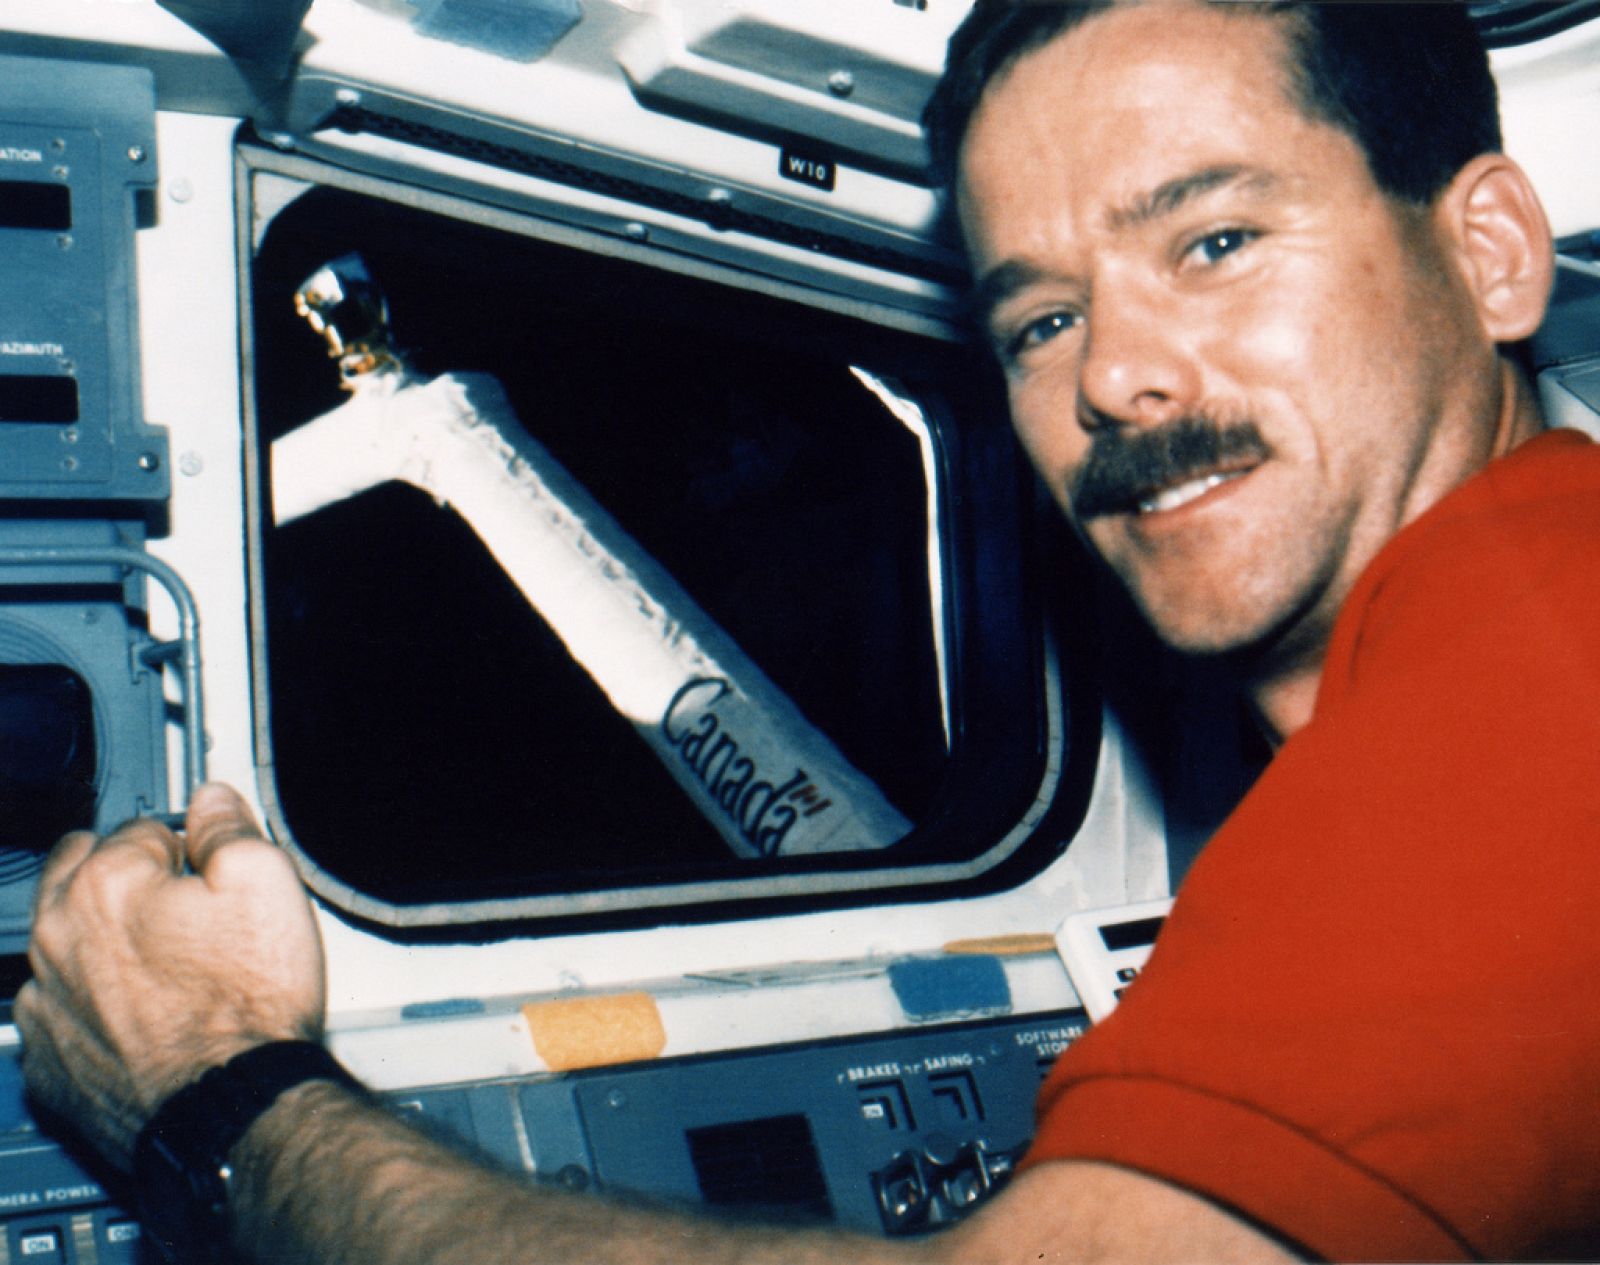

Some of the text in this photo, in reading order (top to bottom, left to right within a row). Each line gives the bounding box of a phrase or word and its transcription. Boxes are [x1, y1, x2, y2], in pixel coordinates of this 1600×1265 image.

[788, 155, 827, 181] W10
[663, 676, 808, 856] Canada
[847, 1053, 973, 1081] BRAKES SAFING
